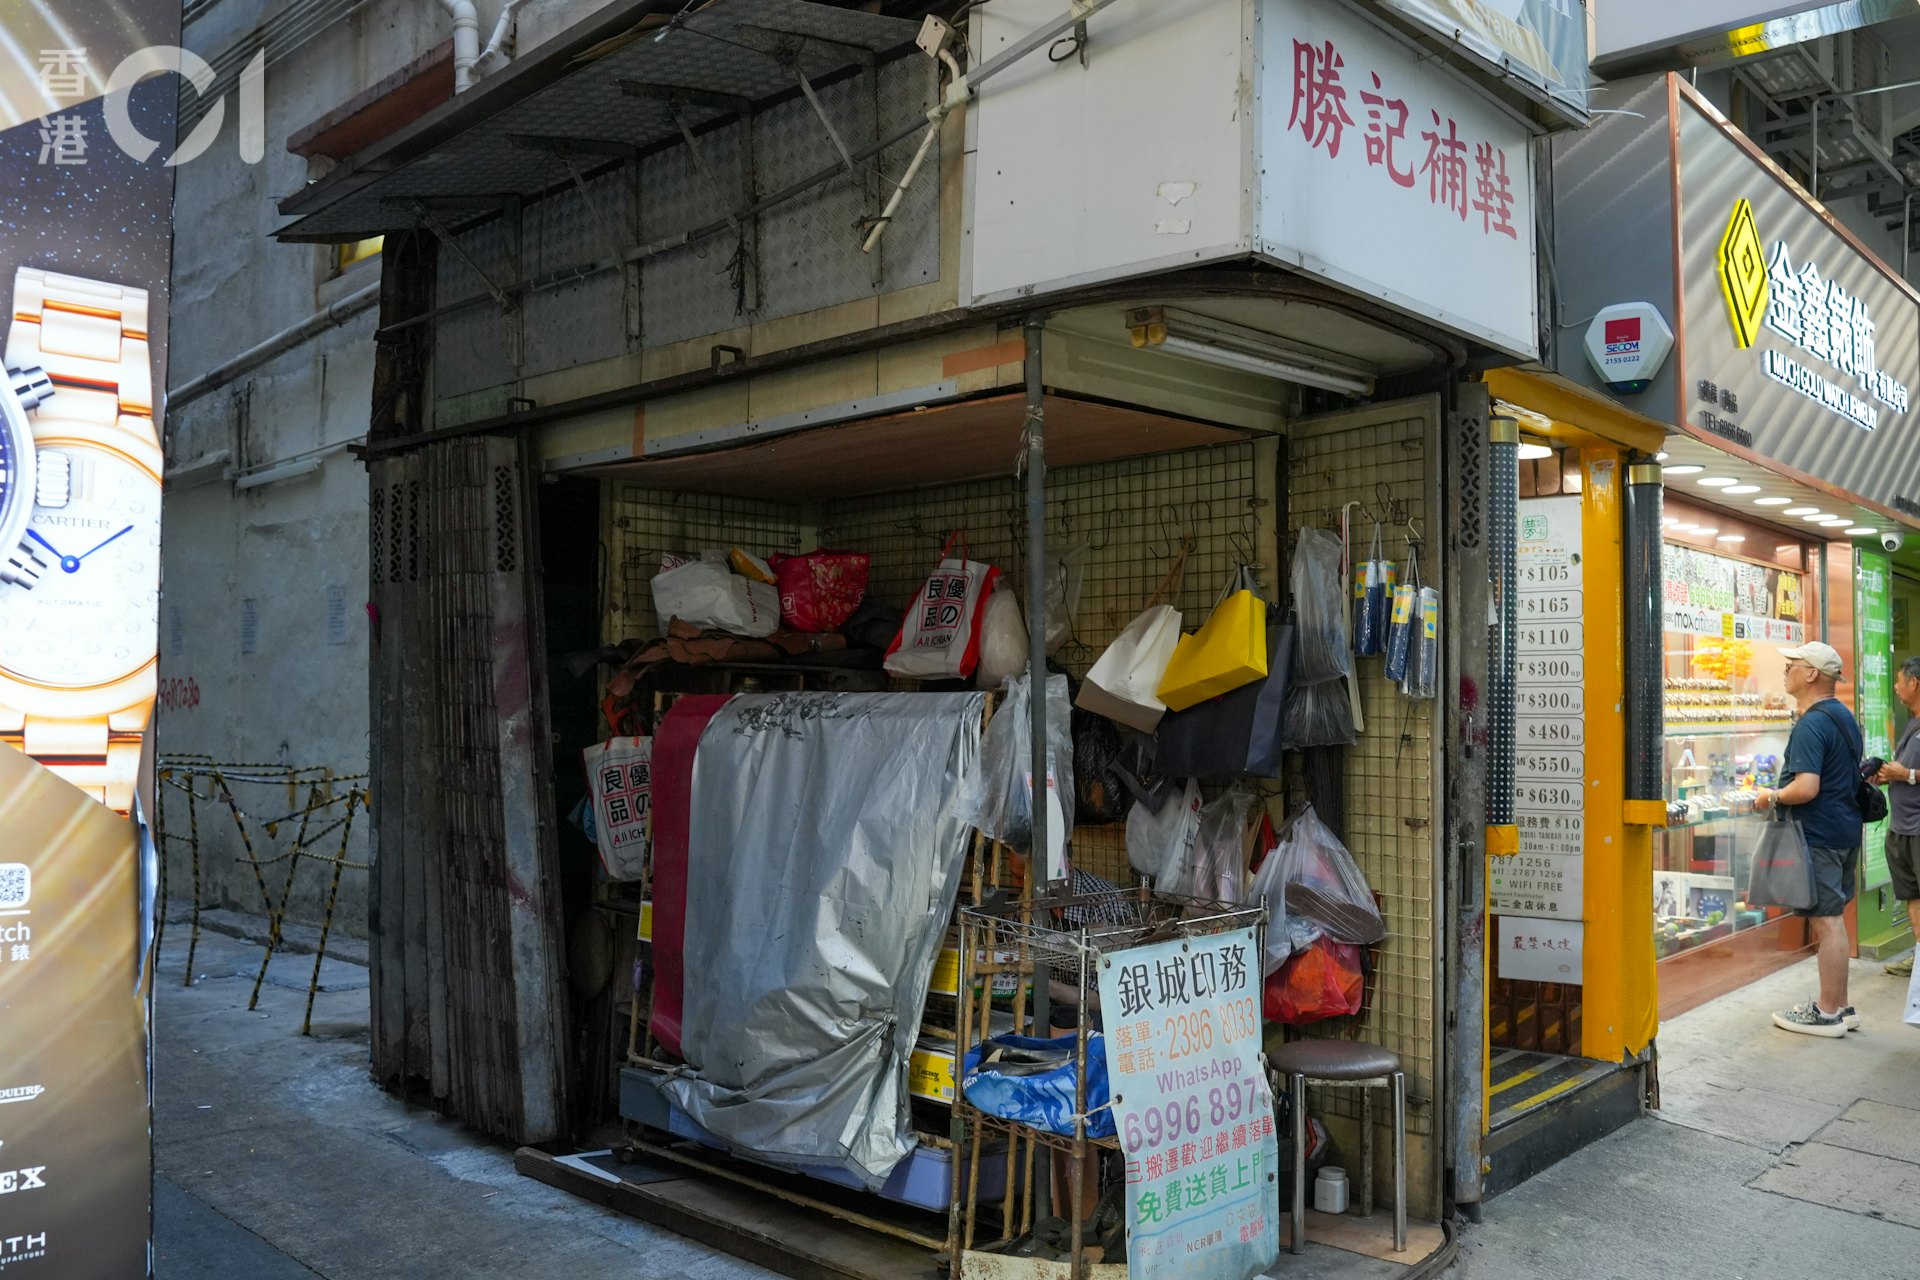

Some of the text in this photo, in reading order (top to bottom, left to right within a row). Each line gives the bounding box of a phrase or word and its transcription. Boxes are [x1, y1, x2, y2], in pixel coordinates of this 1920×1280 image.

[1288, 38, 1517, 240] 勝記補鞋
[1606, 342, 1639, 353] SECOM
[1623, 355, 1640, 363] 0222
[1767, 349, 1800, 390] MUCH
[1799, 365, 1823, 400] GOLD
[1821, 377, 1850, 416] WATCH
[32, 514, 110, 530] CARTIER
[1527, 565, 1569, 582] $105
[1527, 597, 1569, 613] $165
[1527, 628, 1569, 645] $110
[1528, 660, 1569, 677] $300
[1571, 670, 1581, 678] up
[1528, 692, 1570, 709] $300
[1571, 702, 1581, 710] up
[1528, 724, 1581, 742] $480 up
[1528, 756, 1570, 773] $550
[1571, 766, 1581, 774] up
[1528, 788, 1570, 804] $630
[1571, 799, 1581, 807] up
[1555, 818, 1580, 830] $10
[629, 828, 646, 841] ICH
[1519, 858, 1551, 868] 1256
[1512, 868, 1536, 876] 2787
[1540, 870, 1563, 878] 1256
[1509, 880, 1563, 892] WIFI FREE
[1117, 943, 1247, 1018] 銀城印務
[1219, 996, 1256, 1044] 8033
[1156, 1056, 1242, 1094] WhatsApp
[1123, 1094, 1200, 1154] 6996
